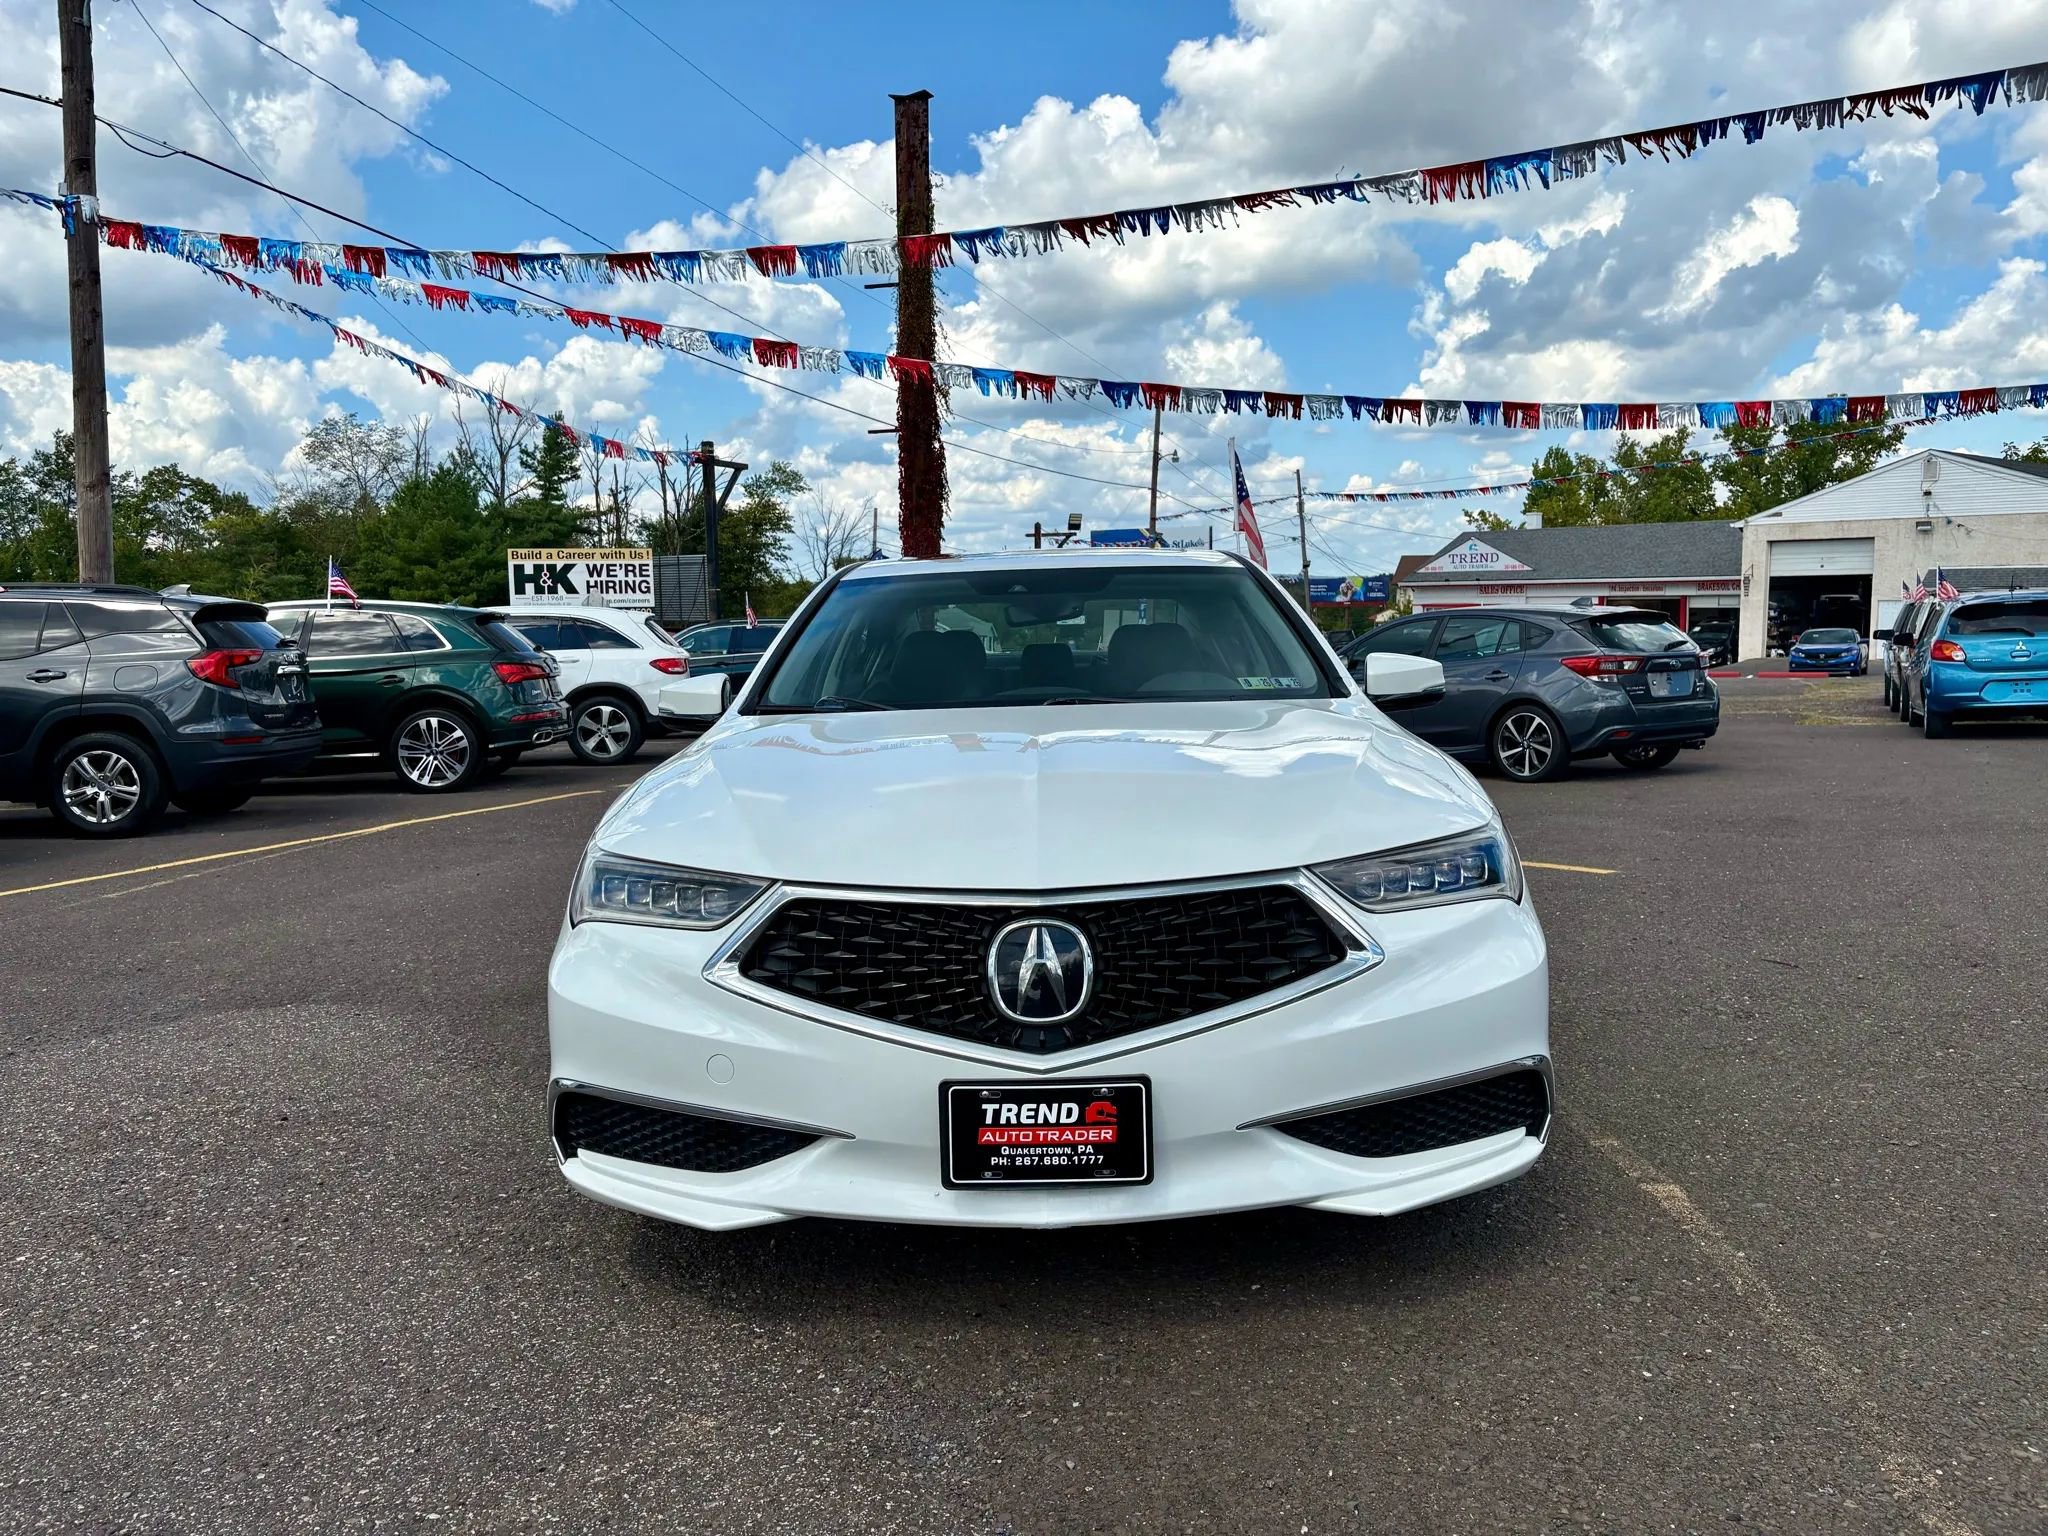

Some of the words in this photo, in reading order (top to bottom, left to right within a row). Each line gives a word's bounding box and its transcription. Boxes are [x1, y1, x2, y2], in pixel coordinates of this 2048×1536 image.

[511, 550, 542, 560] Build
[546, 552, 553, 560] a
[557, 550, 596, 560] Career
[600, 550, 625, 560] with
[1449, 552, 1499, 564] TREND
[585, 563, 651, 578] WE'RE
[513, 563, 579, 595] H&K
[586, 580, 651, 594] HIRING
[1479, 584, 1499, 594] SALES
[1500, 584, 1525, 594] OFFICE
[981, 1102, 1079, 1124] TREND
[981, 1131, 1033, 1143] AUTO
[1036, 1129, 1113, 1142] TRADER
[1078, 1145, 1094, 1154] PA
[991, 1157, 1011, 1166] PH:
[1015, 1155, 1104, 1166] 267.680.1777
